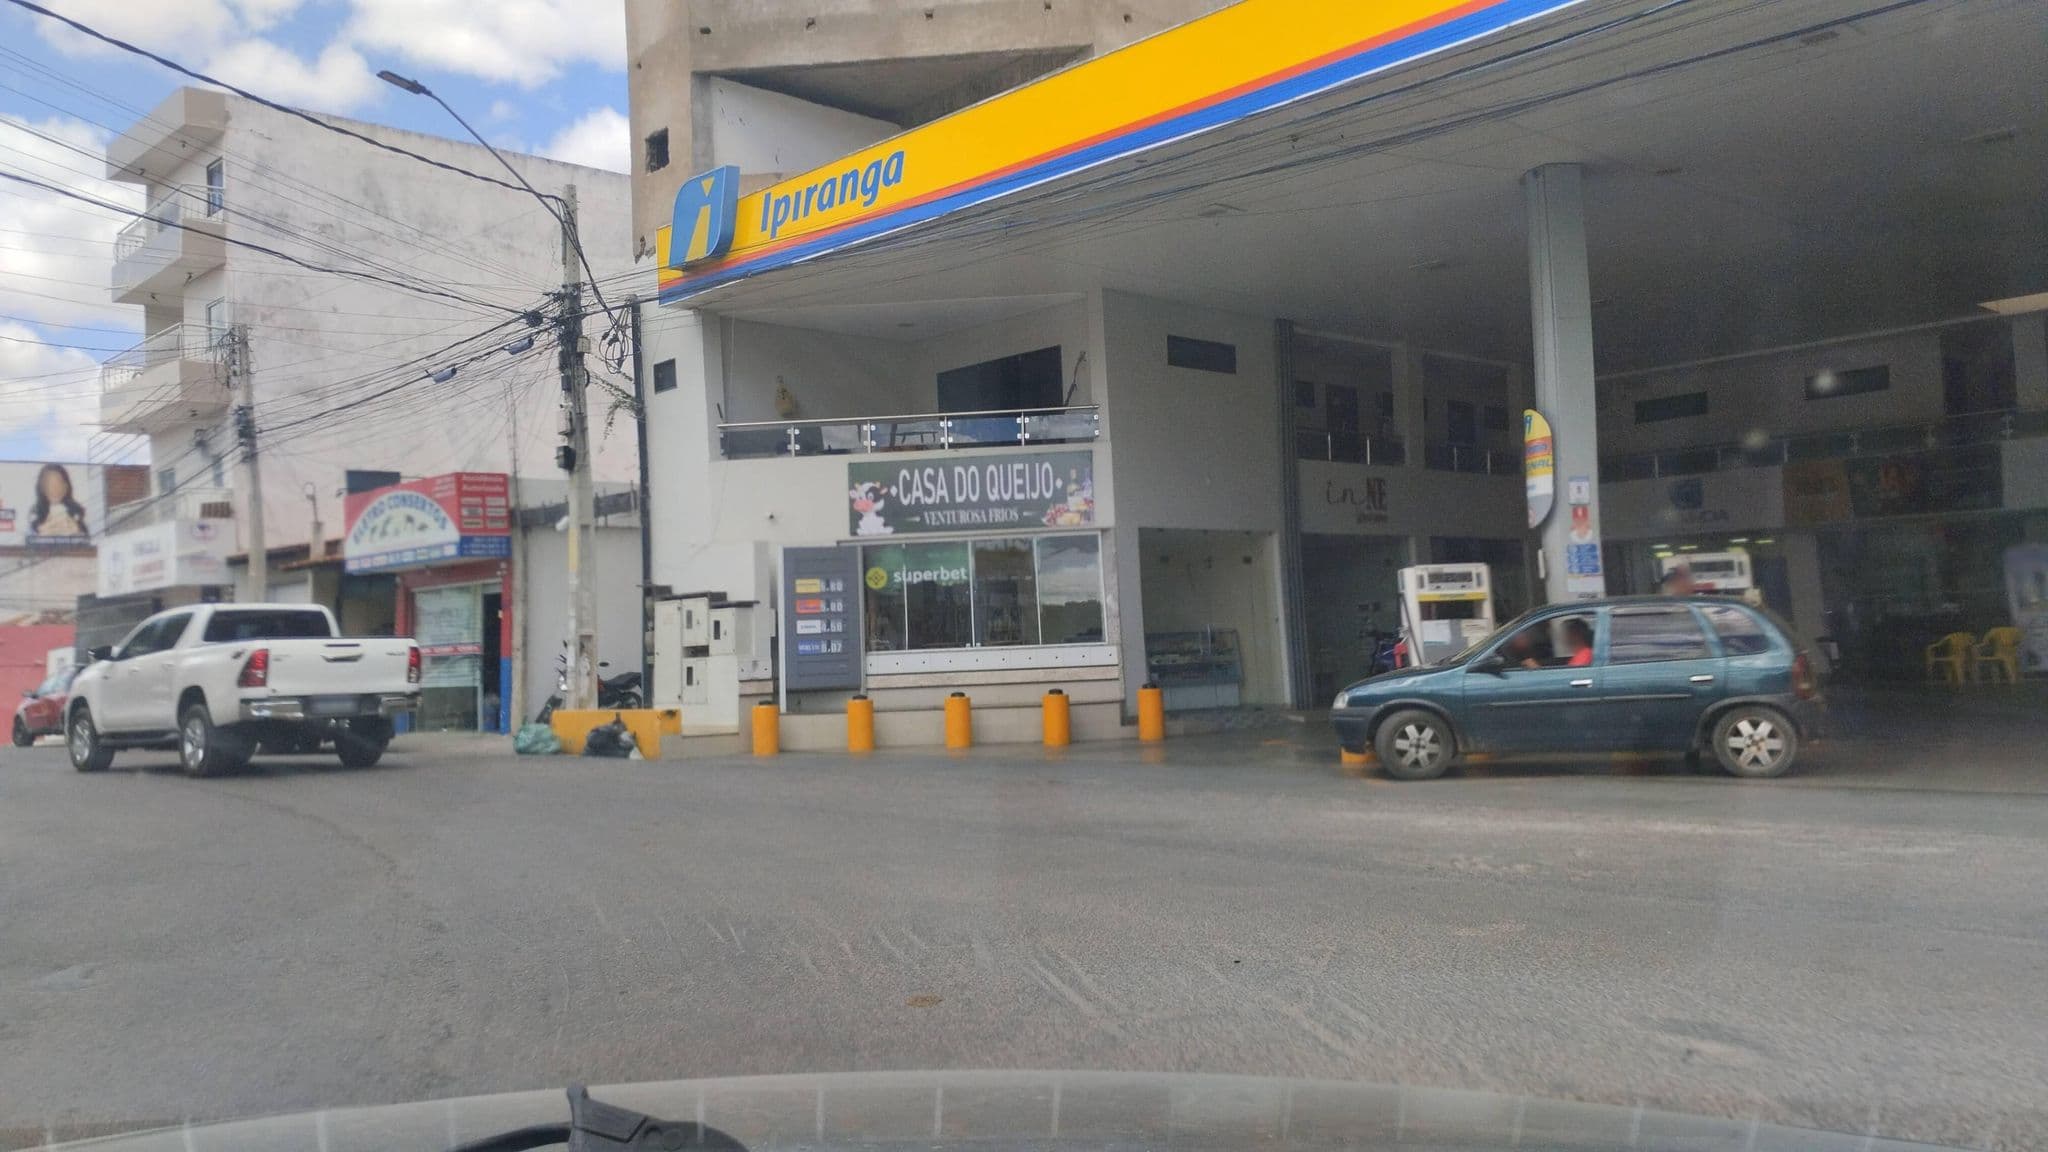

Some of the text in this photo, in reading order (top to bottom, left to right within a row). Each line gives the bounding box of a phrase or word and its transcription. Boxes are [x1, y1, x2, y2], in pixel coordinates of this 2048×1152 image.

[760, 151, 905, 239] Ipiranga
[899, 462, 1053, 505] CASA DO QUEIJO
[924, 507, 1019, 526] VENTUROSA FRIOS
[893, 566, 968, 585] superbet
